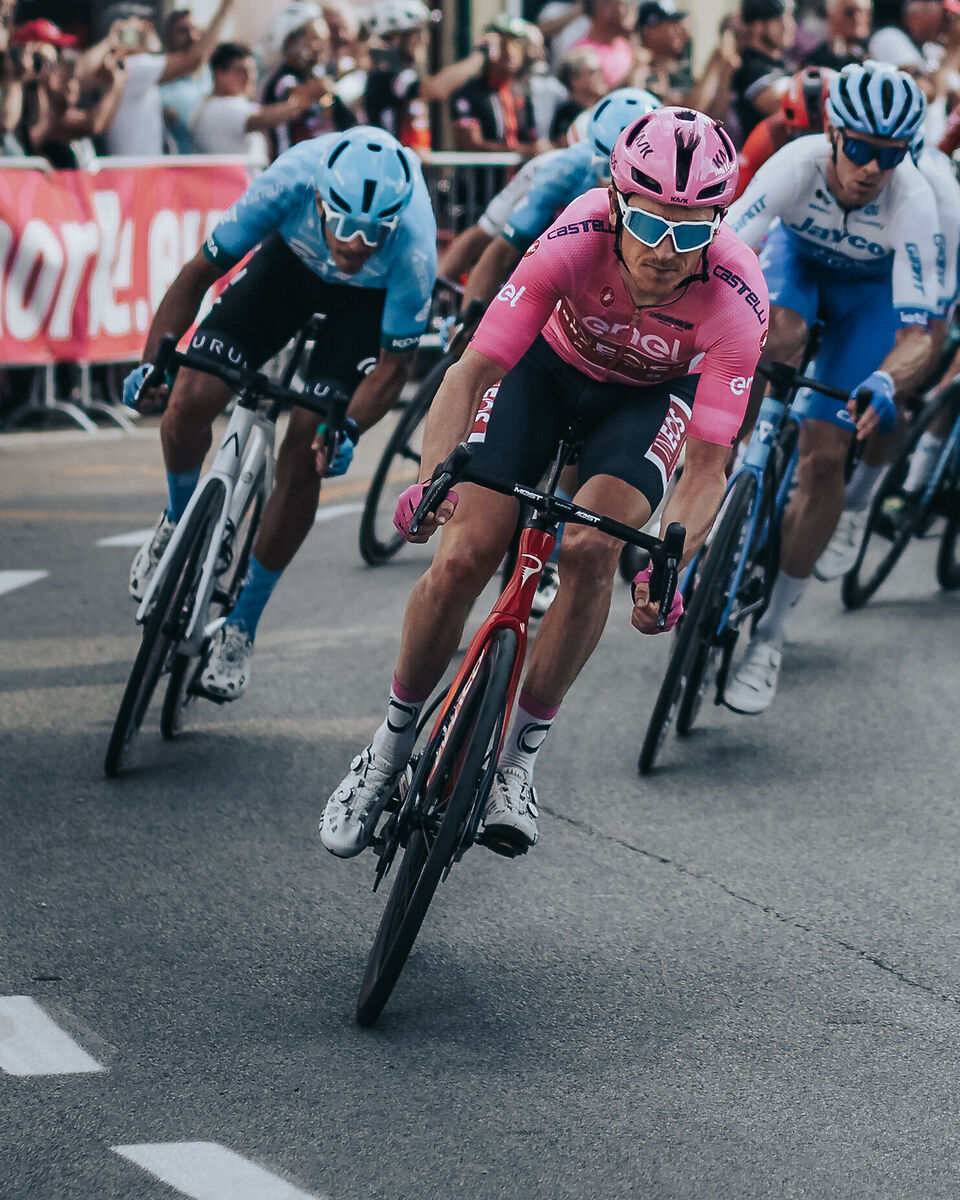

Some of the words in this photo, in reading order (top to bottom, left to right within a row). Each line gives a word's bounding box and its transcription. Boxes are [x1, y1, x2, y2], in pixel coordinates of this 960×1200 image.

[789, 216, 886, 256] Jayco
[192, 335, 248, 369] URU
[582, 316, 681, 363] enel
[653, 407, 686, 463] INEOS
[513, 486, 543, 501] MOST
